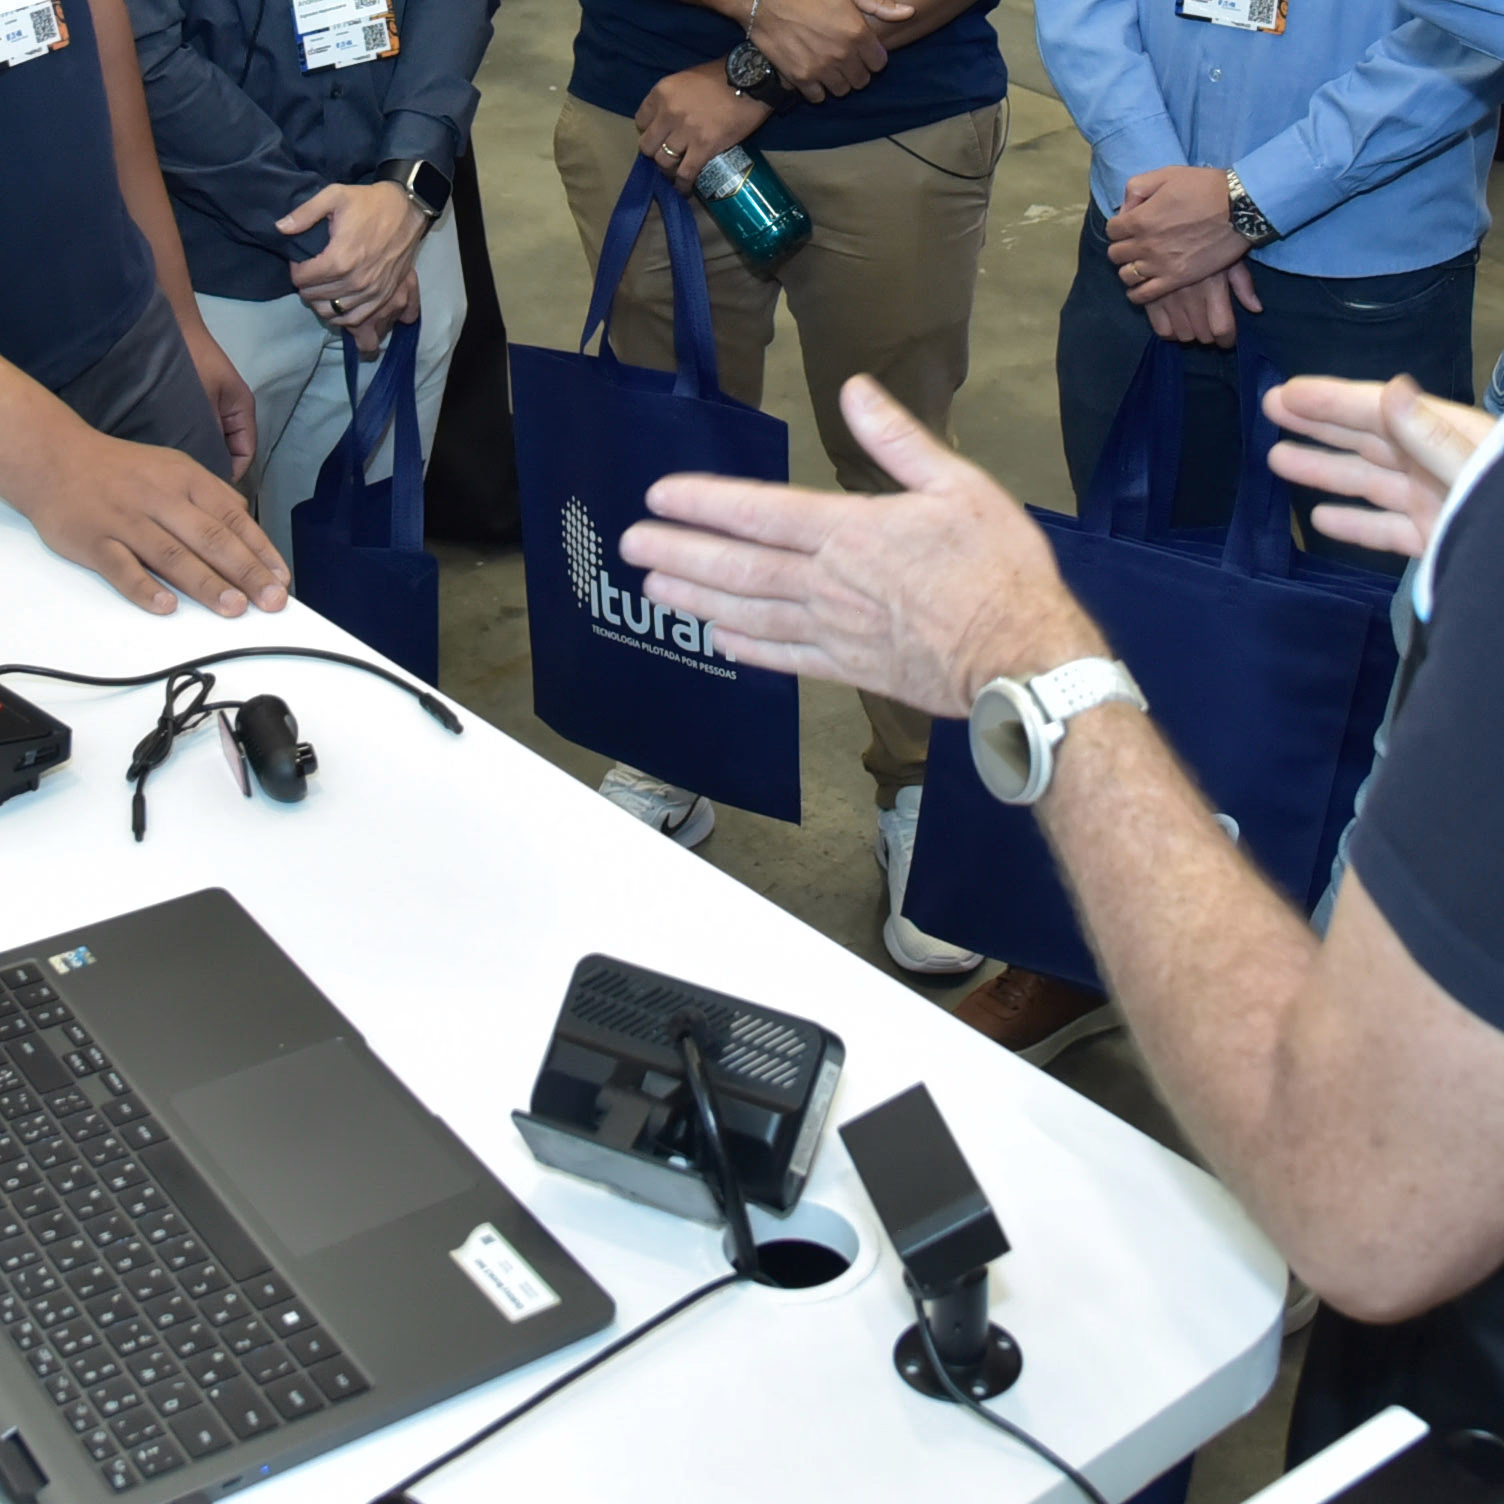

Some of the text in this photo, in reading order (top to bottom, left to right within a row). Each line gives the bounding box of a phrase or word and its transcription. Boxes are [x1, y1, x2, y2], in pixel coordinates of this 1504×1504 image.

[592, 624, 737, 680] TECNOLOGIA PILOTADA POR PESSOAS
